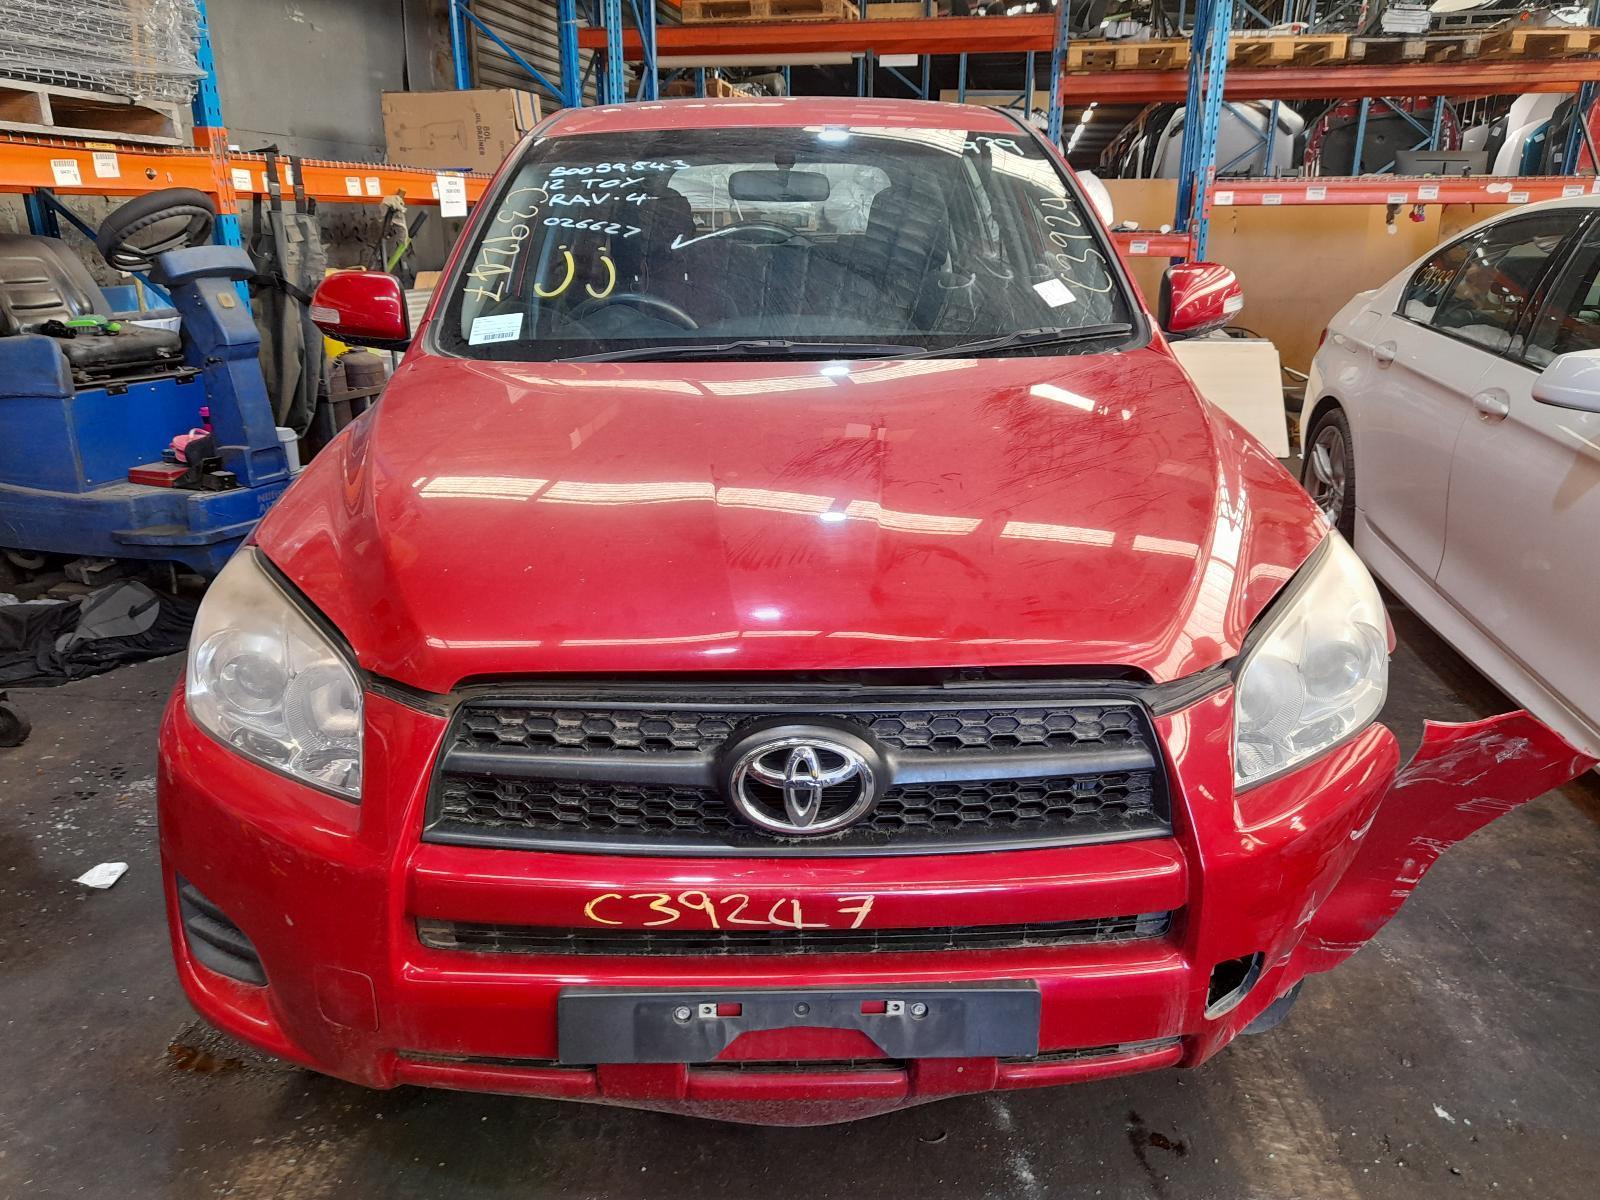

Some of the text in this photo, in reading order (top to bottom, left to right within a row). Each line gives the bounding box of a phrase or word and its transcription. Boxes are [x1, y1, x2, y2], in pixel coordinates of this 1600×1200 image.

[476, 126, 485, 155] DRAINER
[581, 177, 645, 189] TOY
[463, 187, 549, 303] C39247
[583, 890, 876, 930] C39247
